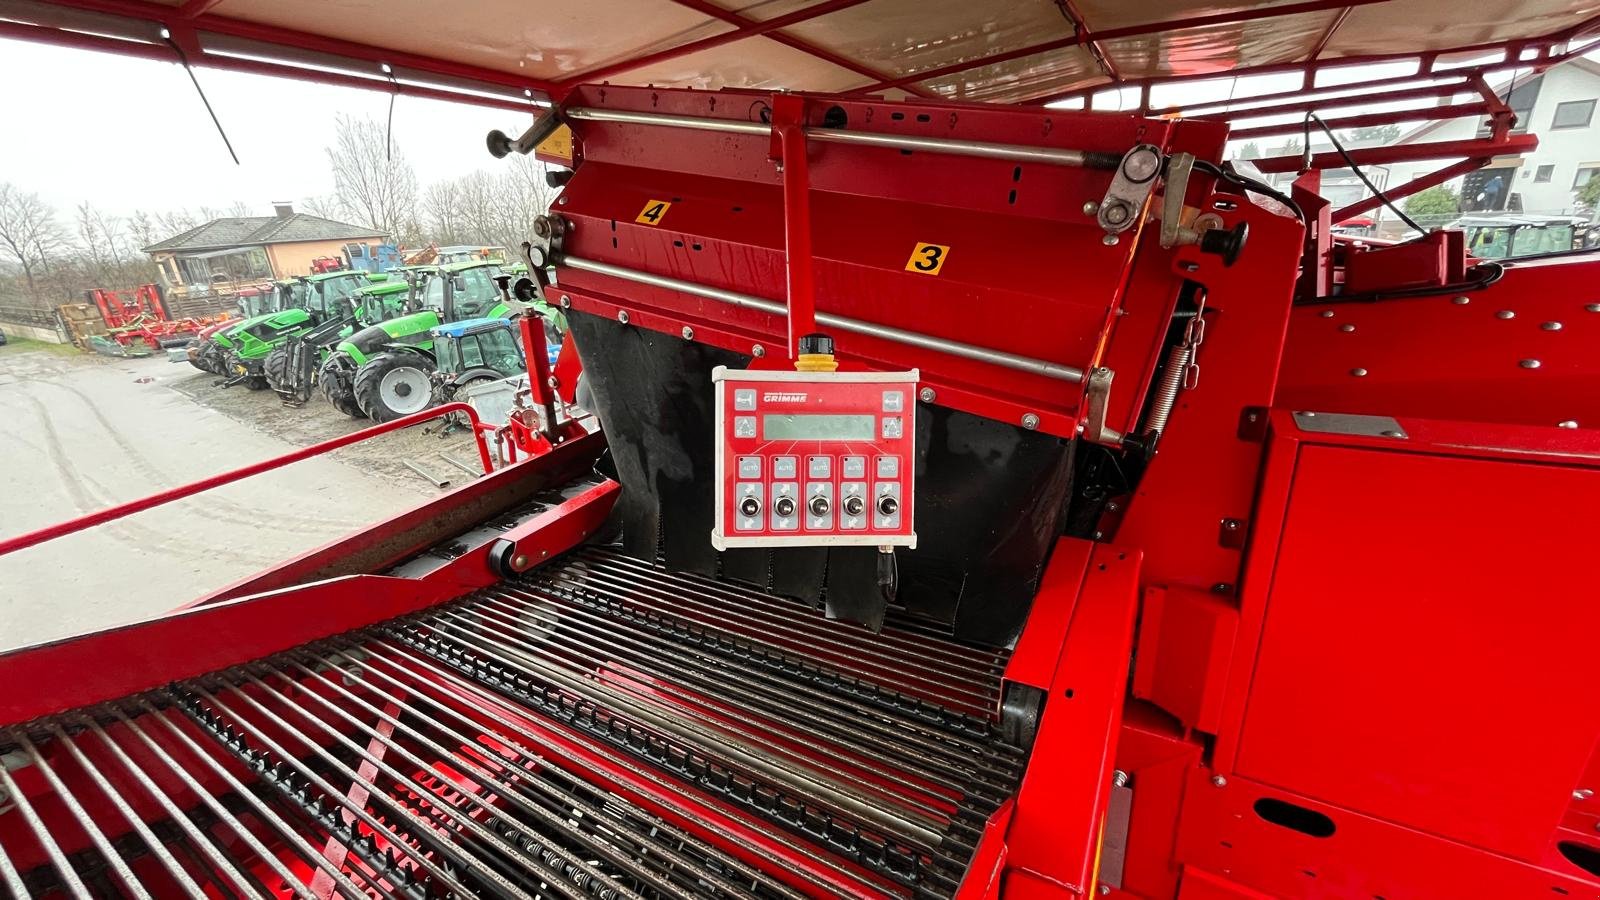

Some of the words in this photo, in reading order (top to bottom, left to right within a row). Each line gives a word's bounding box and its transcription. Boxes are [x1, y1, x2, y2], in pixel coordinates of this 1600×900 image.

[643, 203, 665, 222] 4
[915, 246, 943, 271] 3
[763, 392, 808, 403] GRIMME
